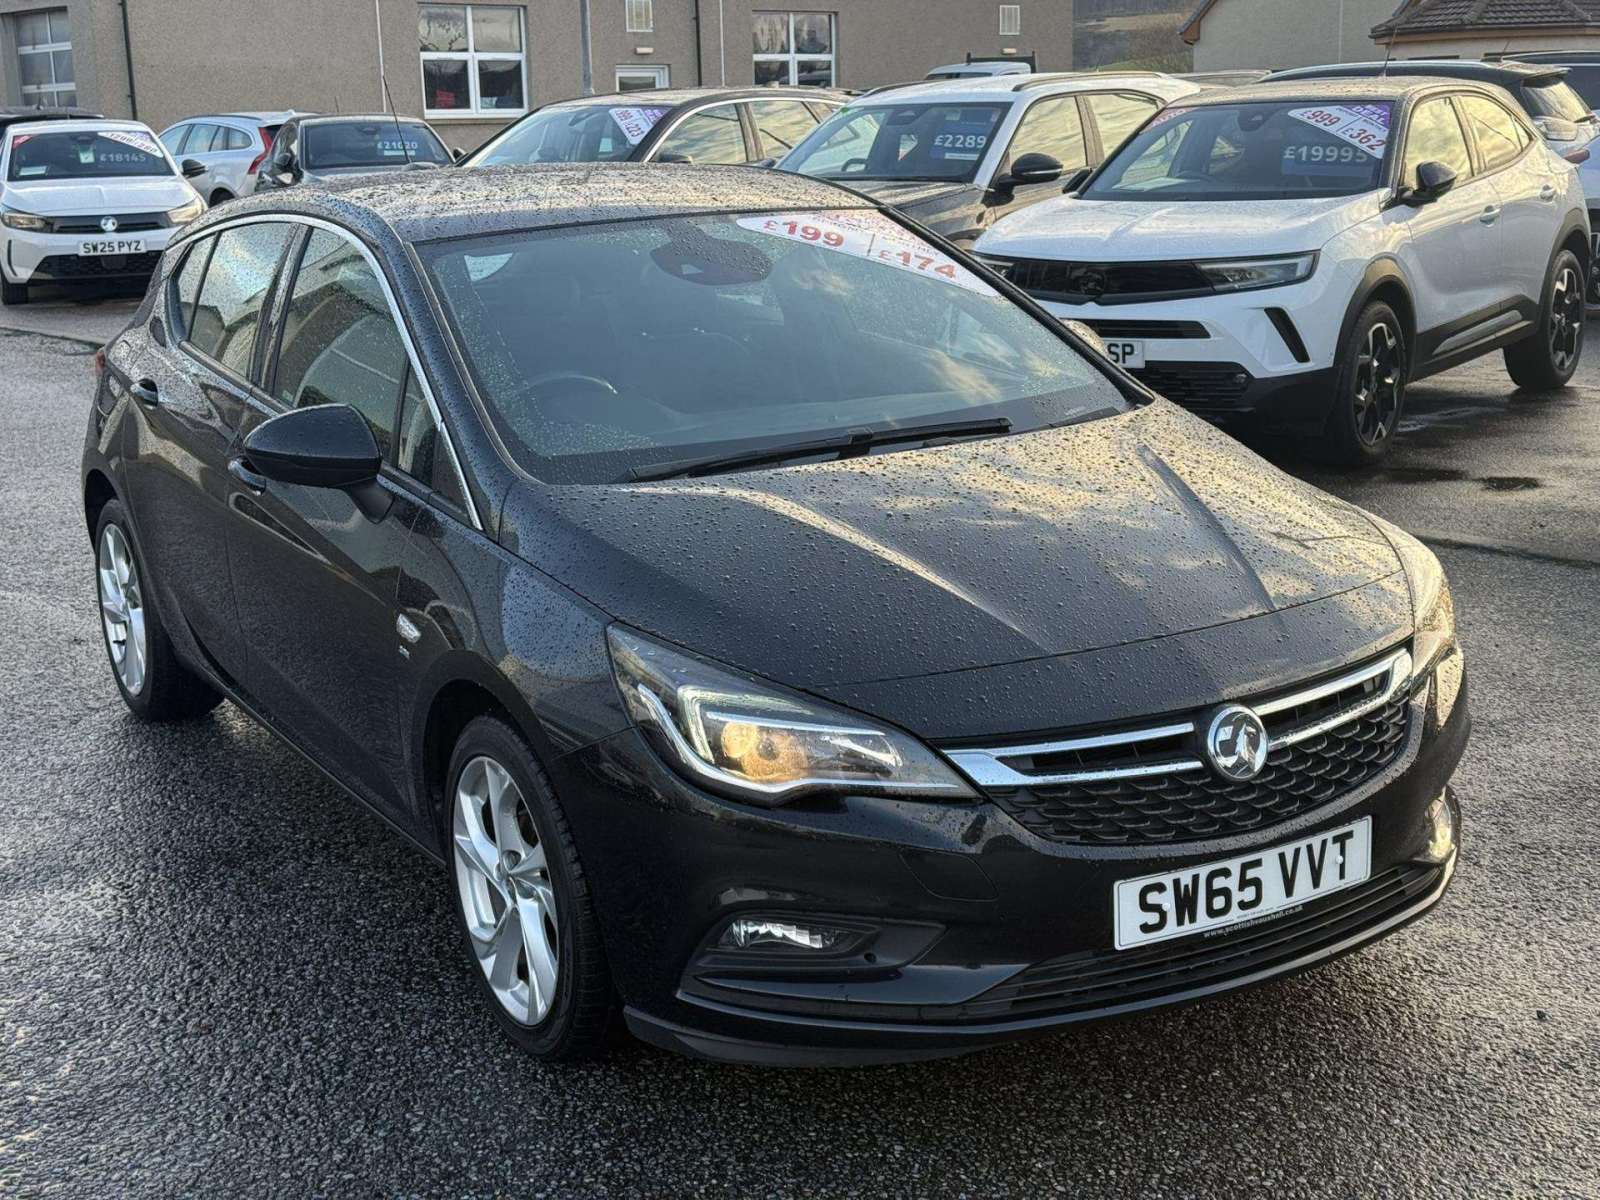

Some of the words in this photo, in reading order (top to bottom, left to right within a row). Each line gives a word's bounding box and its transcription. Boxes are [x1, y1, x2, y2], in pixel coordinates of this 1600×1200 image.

[1343, 128, 1386, 151] £362
[82, 240, 115, 254] SW25
[118, 240, 142, 252] PYZ
[763, 220, 845, 247] £199
[879, 249, 957, 278] £174
[1139, 858, 1264, 934] SW65
[1278, 830, 1354, 899] VVT
